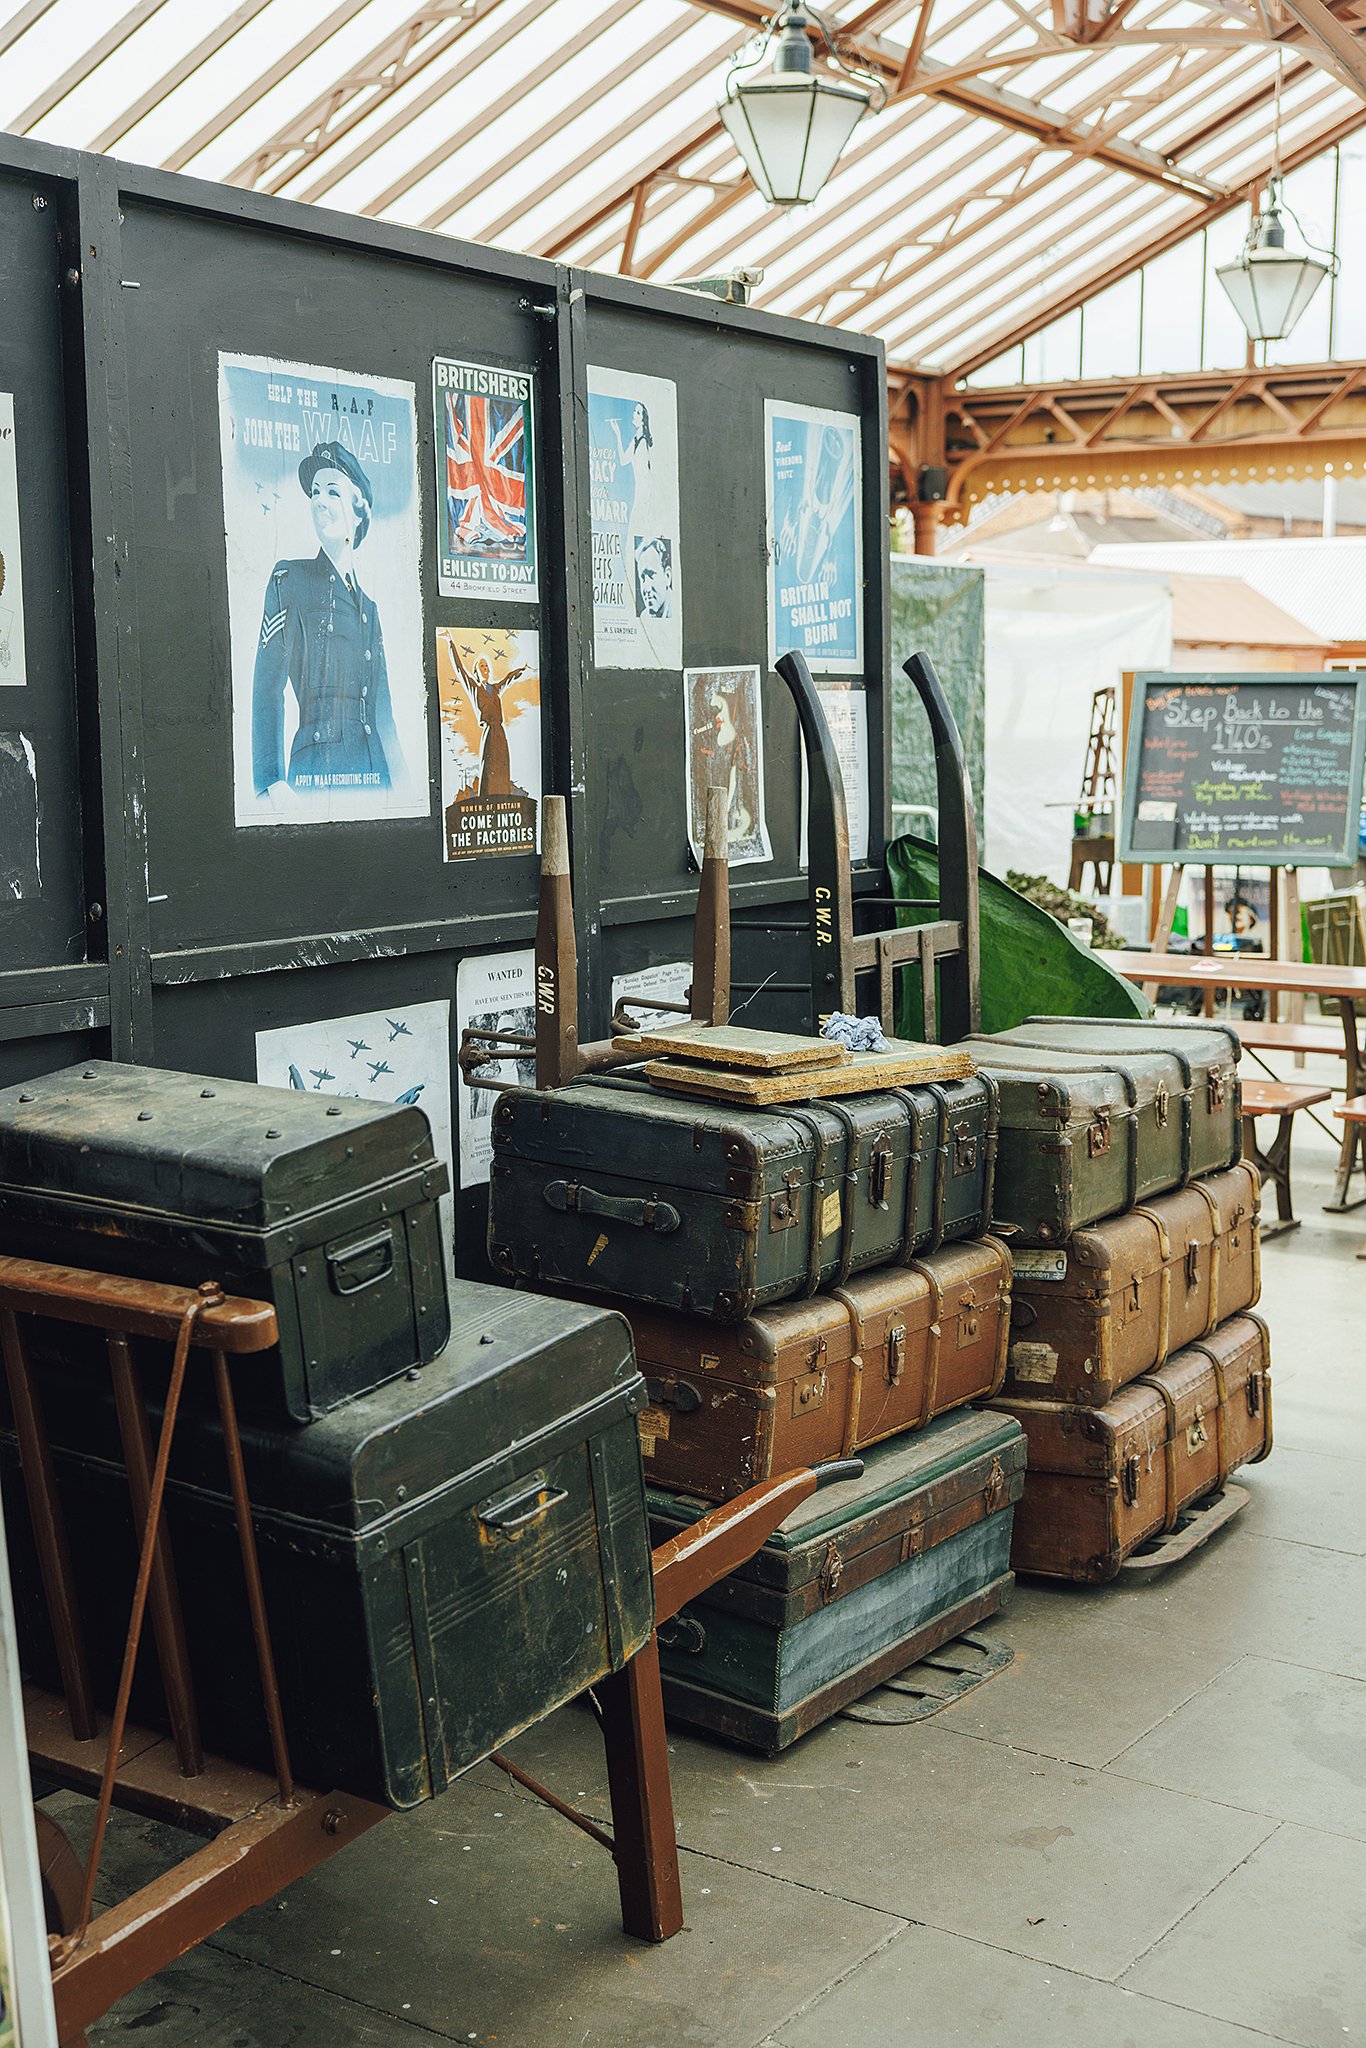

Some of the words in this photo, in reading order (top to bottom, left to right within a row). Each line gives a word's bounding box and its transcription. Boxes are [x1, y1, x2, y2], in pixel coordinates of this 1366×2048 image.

[437, 364, 528, 400] BRITISHERS
[267, 384, 292, 404] HELP
[297, 388, 318, 407] THE
[243, 417, 273, 448] JOIN
[275, 422, 300, 452] THE
[302, 410, 397, 464] WAAF
[443, 559, 487, 579] ENLIST
[450, 581, 461, 589] 44
[781, 582, 830, 608] BRITAIN
[791, 603, 828, 628] SHALL
[829, 598, 852, 620] NOT
[804, 622, 838, 647] BURN
[1164, 698, 1218, 733] Step
[1222, 694, 1263, 721] Back
[1269, 699, 1290, 719] to
[1298, 698, 1324, 719] the
[295, 774, 312, 787] APPLY
[314, 774, 331, 786] WAAF
[332, 773, 361, 786] RECRUITING
[363, 772, 381, 785] OFFICE
[461, 804, 482, 813] WOMEN
[486, 803, 493, 811] OF
[497, 802, 520, 811] BRITAIN
[461, 814, 492, 830] COME
[497, 812, 522, 828] INTO
[451, 832, 471, 848] THE
[476, 827, 534, 846] FACTORIES
[488, 968, 523, 981] WANTED
[474, 998, 488, 1006] HAVE
